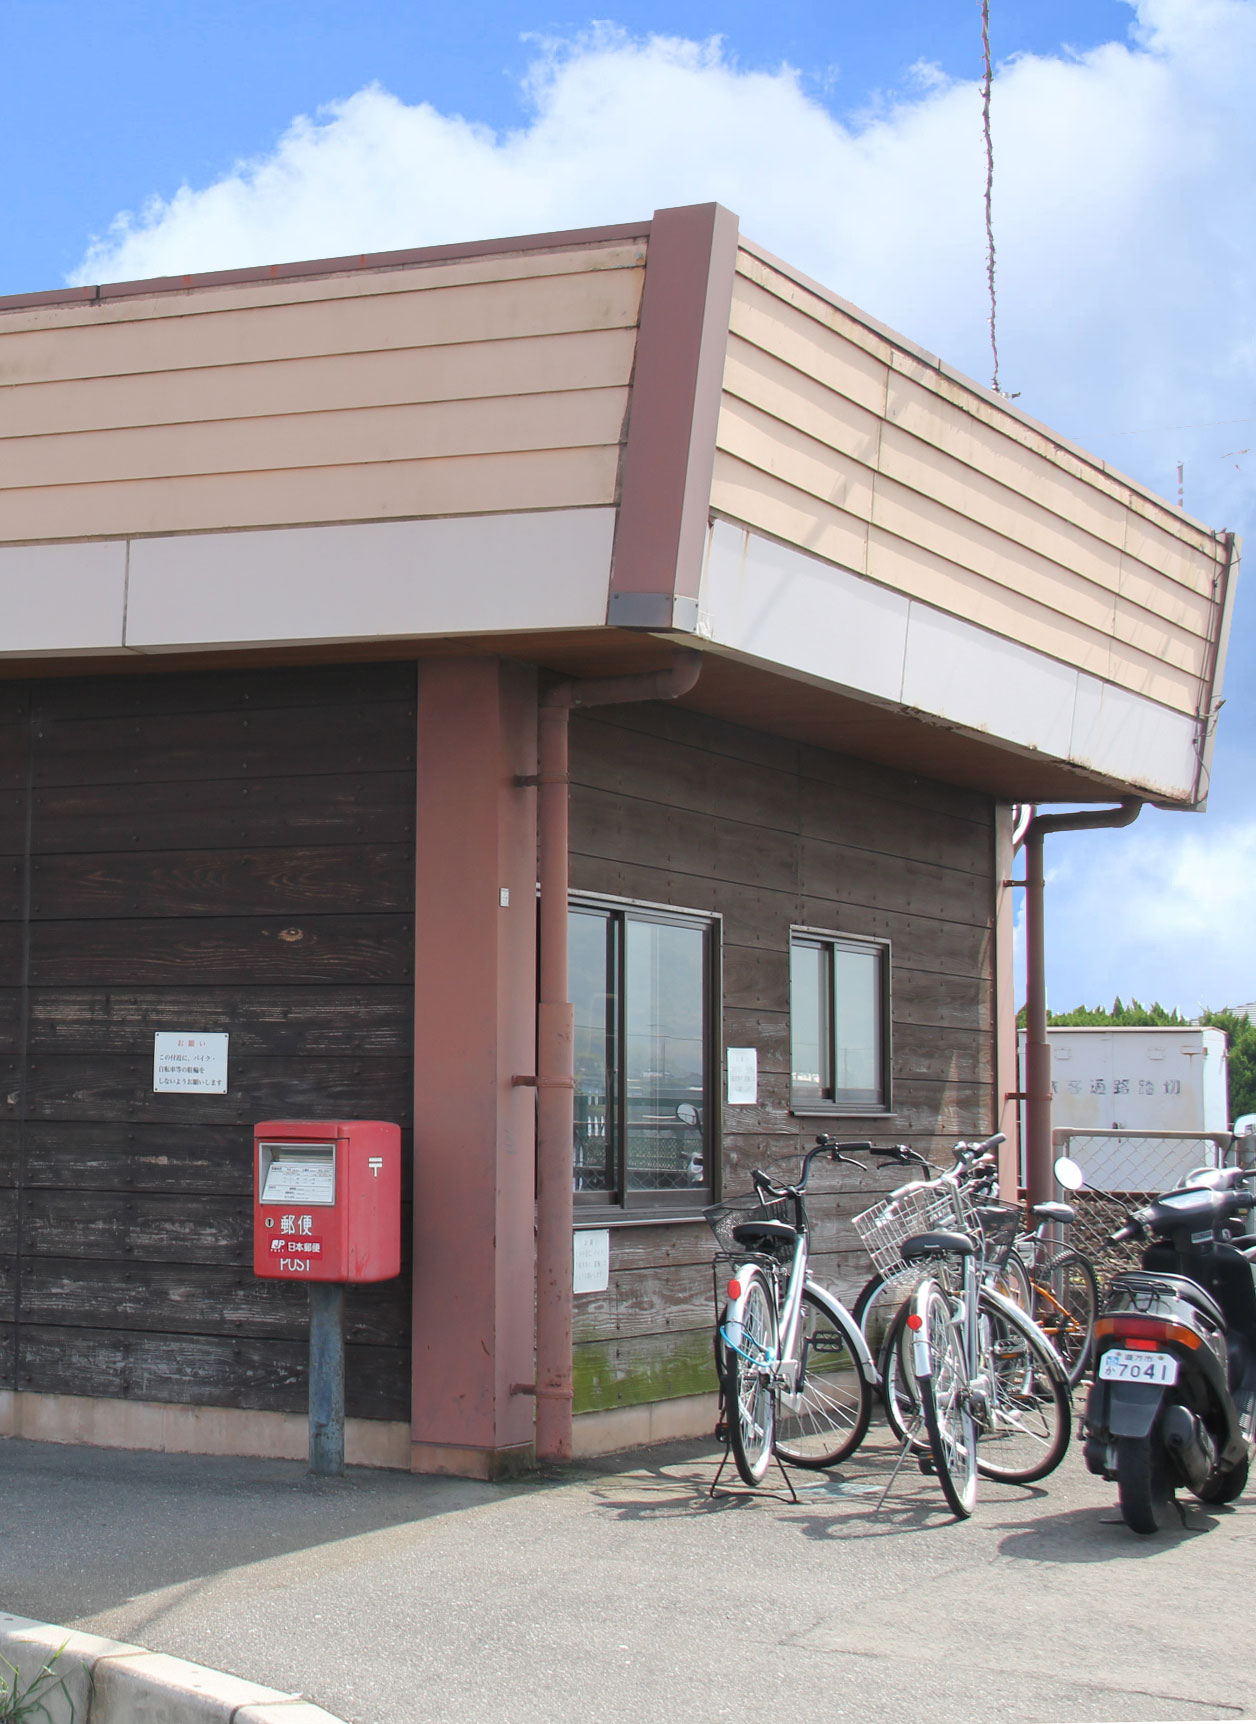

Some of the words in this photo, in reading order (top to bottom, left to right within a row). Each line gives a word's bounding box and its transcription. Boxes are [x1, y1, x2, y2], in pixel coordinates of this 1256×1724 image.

[280, 1214, 313, 1236] 郵便
[287, 1242, 321, 1253] 日本郵便
[280, 1258, 311, 1272] POST
[1118, 1363, 1167, 1381] 7041
